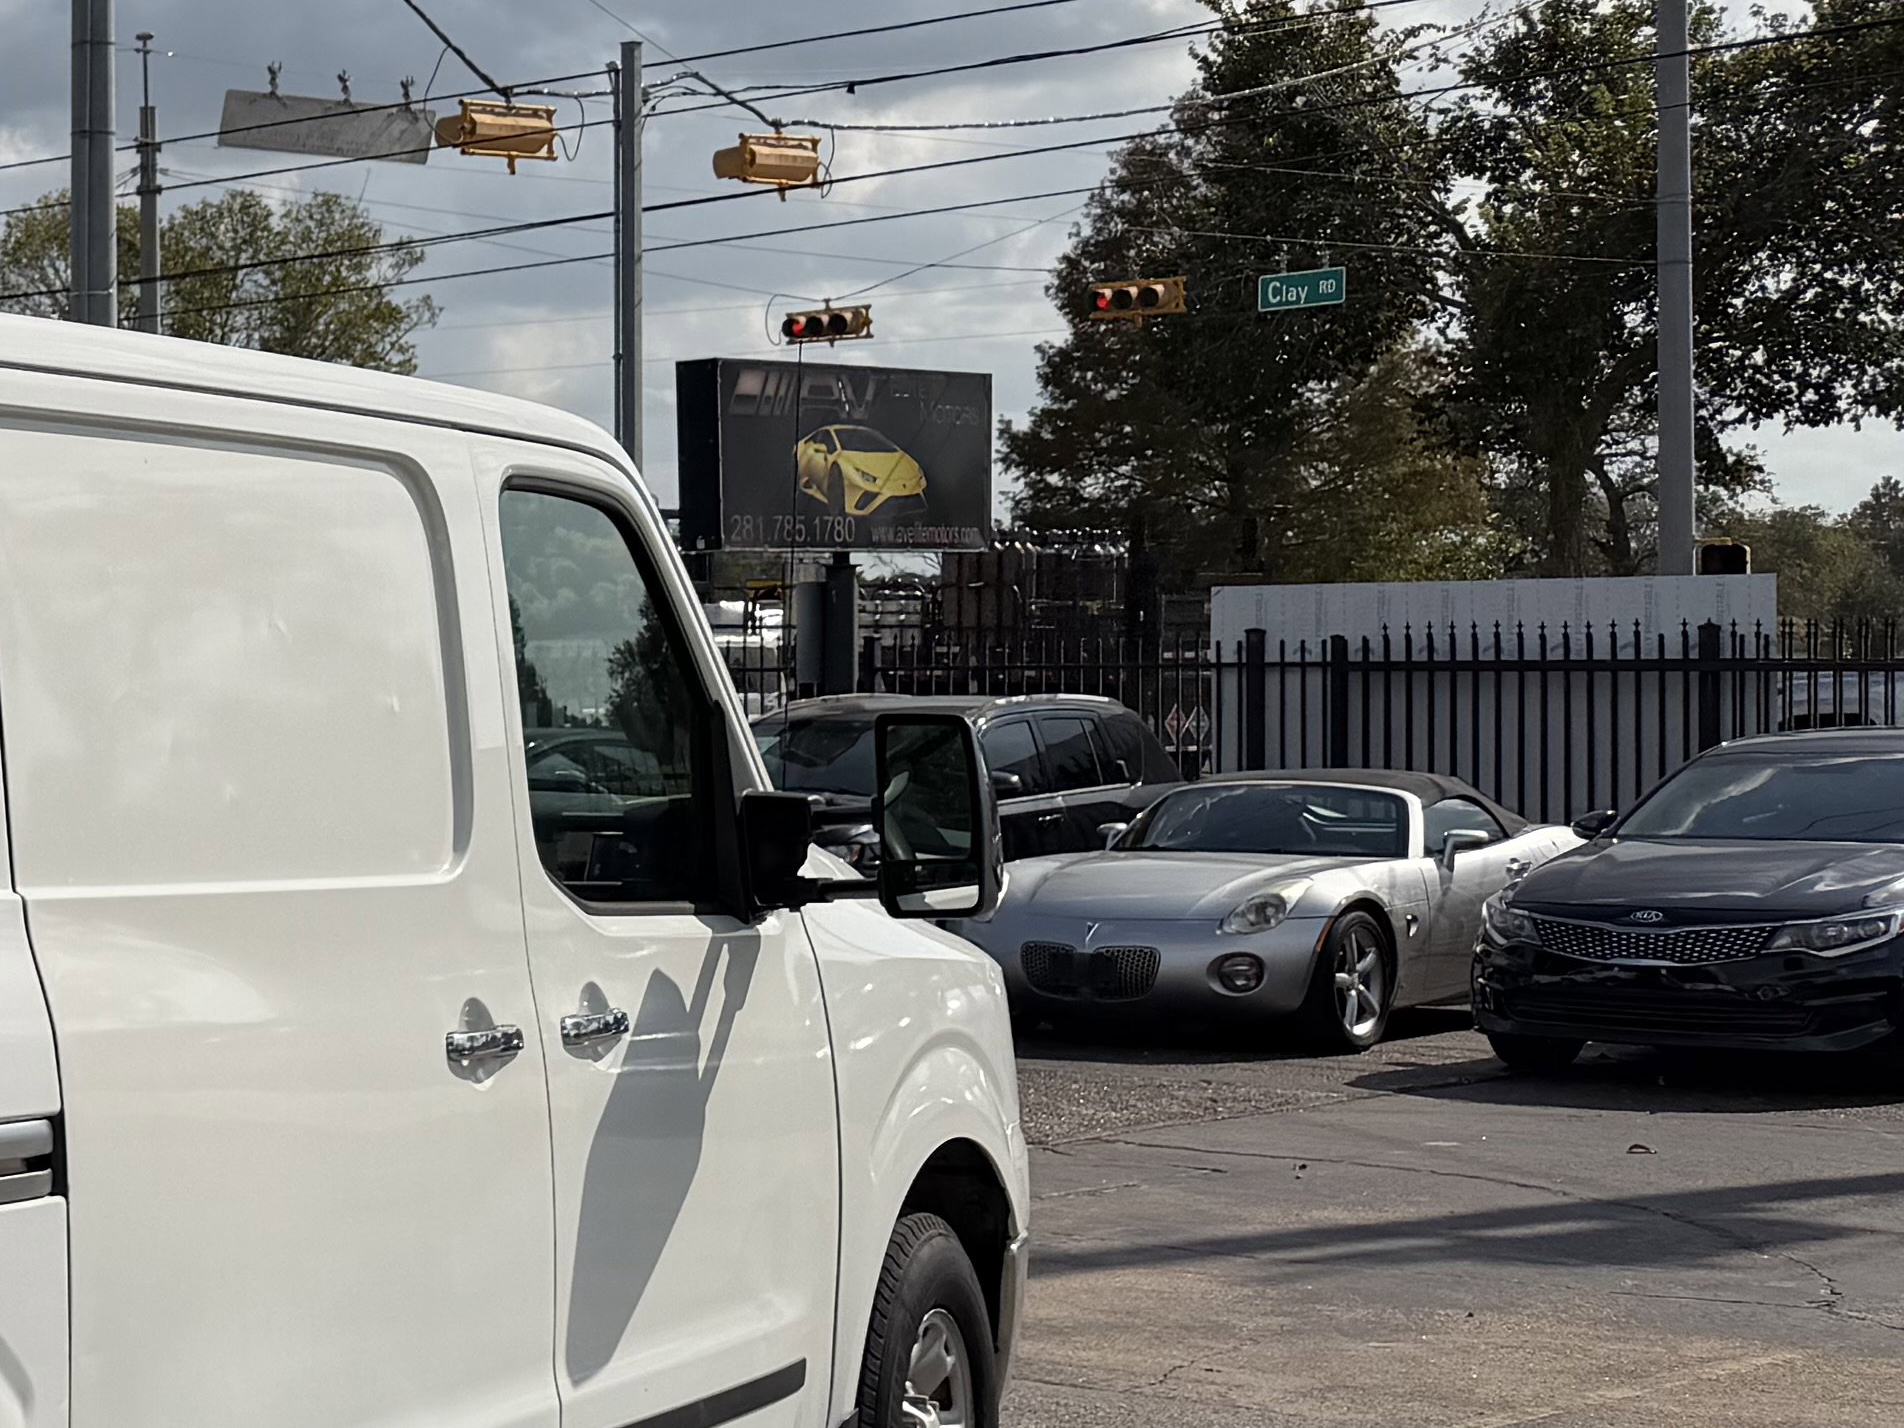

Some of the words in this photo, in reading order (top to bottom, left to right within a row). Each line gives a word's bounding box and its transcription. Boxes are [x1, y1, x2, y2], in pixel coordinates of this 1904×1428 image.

[1268, 281, 1308, 304] Clay
[1319, 279, 1336, 294] RD
[730, 515, 856, 542] 281.785.1780
